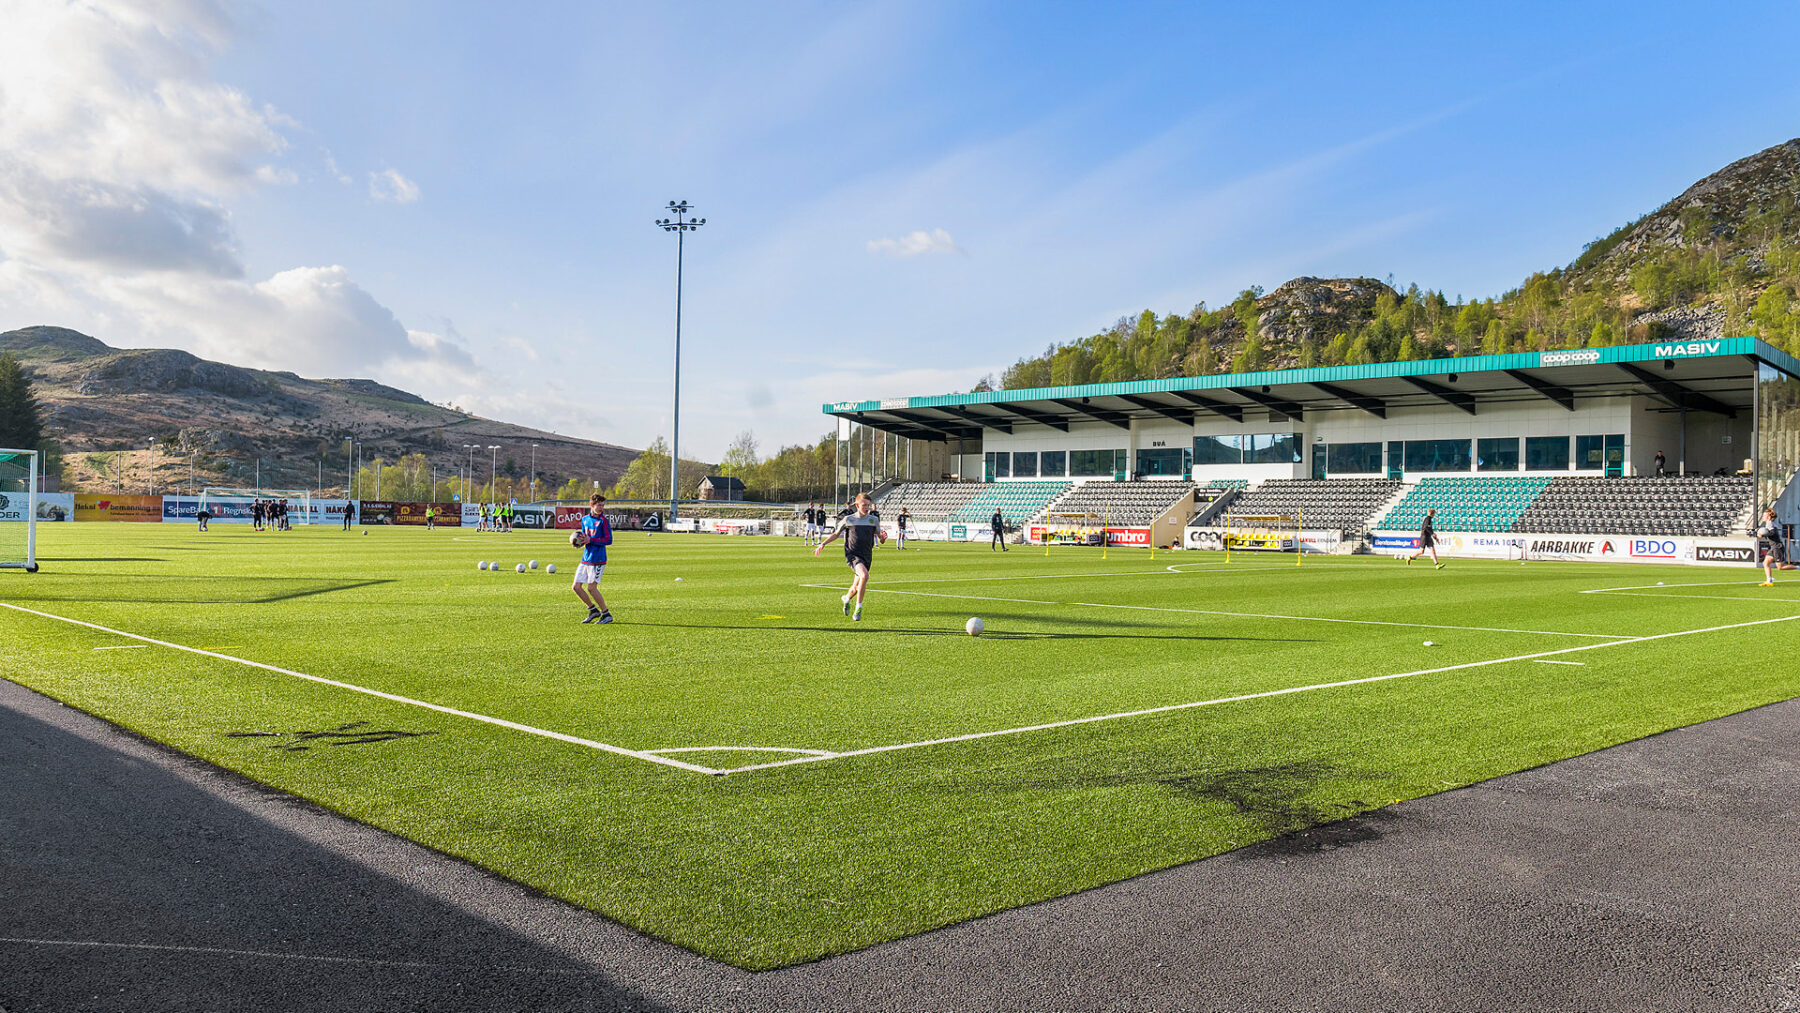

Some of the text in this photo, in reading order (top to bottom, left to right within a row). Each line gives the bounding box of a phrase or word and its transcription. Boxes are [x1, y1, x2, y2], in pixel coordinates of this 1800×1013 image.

[1655, 342, 1720, 357] MASIV
[1543, 352, 1600, 364] coop coop
[833, 402, 857, 411] MASIV
[512, 515, 551, 524] ASIV
[1107, 530, 1146, 542] umbro
[1531, 541, 1595, 554] AARBAKKE
[1635, 540, 1676, 554] BDO
[1698, 549, 1751, 560] MASIV
